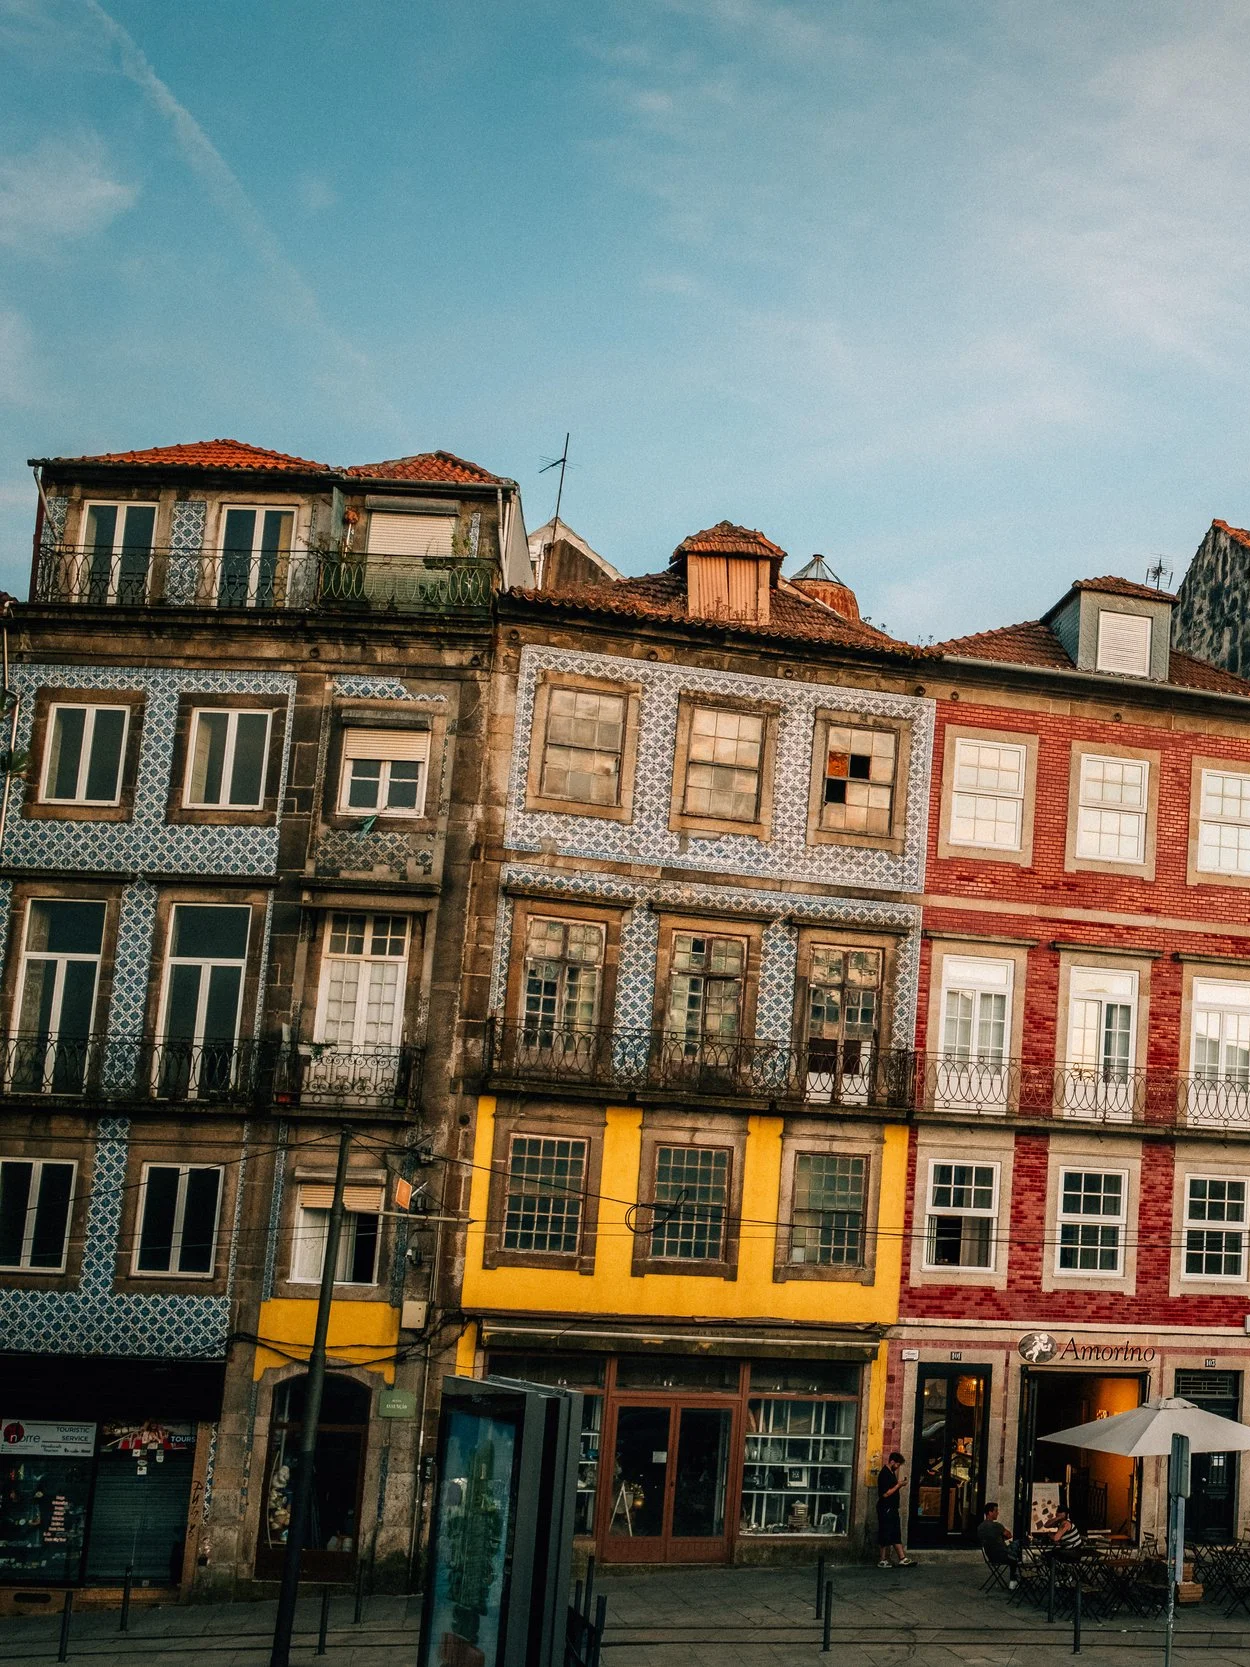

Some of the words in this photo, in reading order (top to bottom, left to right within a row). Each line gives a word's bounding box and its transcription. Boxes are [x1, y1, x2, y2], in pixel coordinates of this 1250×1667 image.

[1060, 1337, 1155, 1362] Amorino
[56, 1426, 91, 1434] TOURISTIC
[170, 1435, 196, 1443] TOURS
